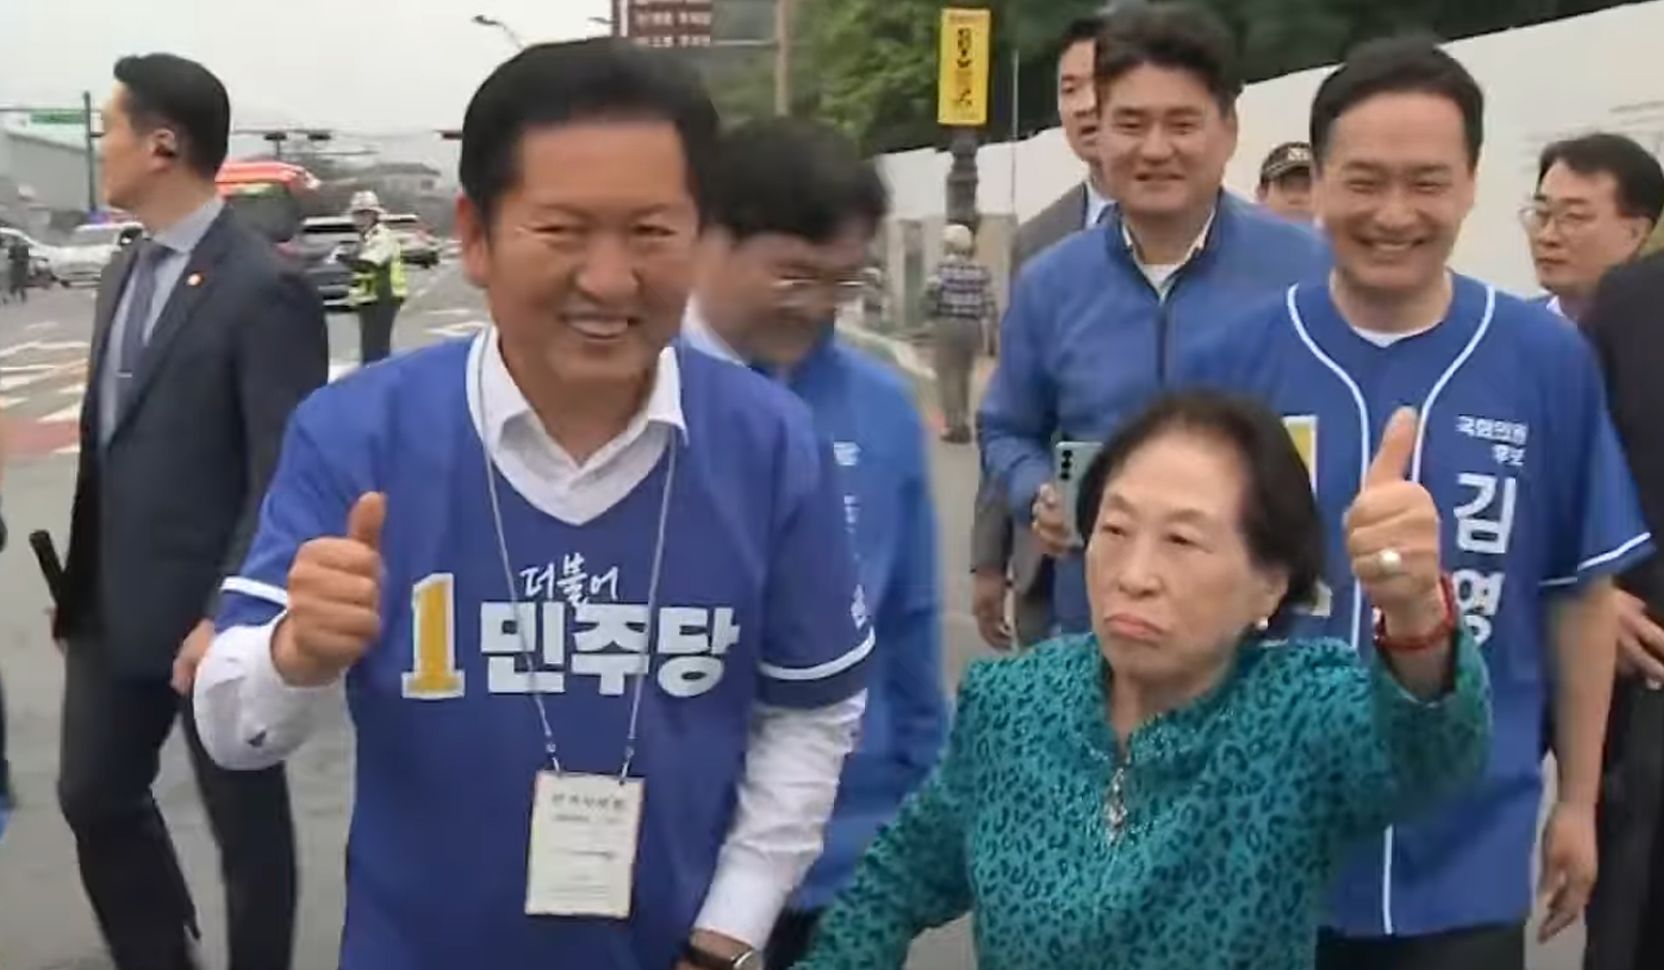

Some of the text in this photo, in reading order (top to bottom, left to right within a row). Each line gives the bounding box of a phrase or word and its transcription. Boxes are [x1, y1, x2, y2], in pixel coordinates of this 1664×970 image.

[1491, 444, 1527, 467] 후보
[519, 552, 620, 609] 더불어
[401, 572, 466, 700] 1
[480, 601, 741, 698] 민주당
